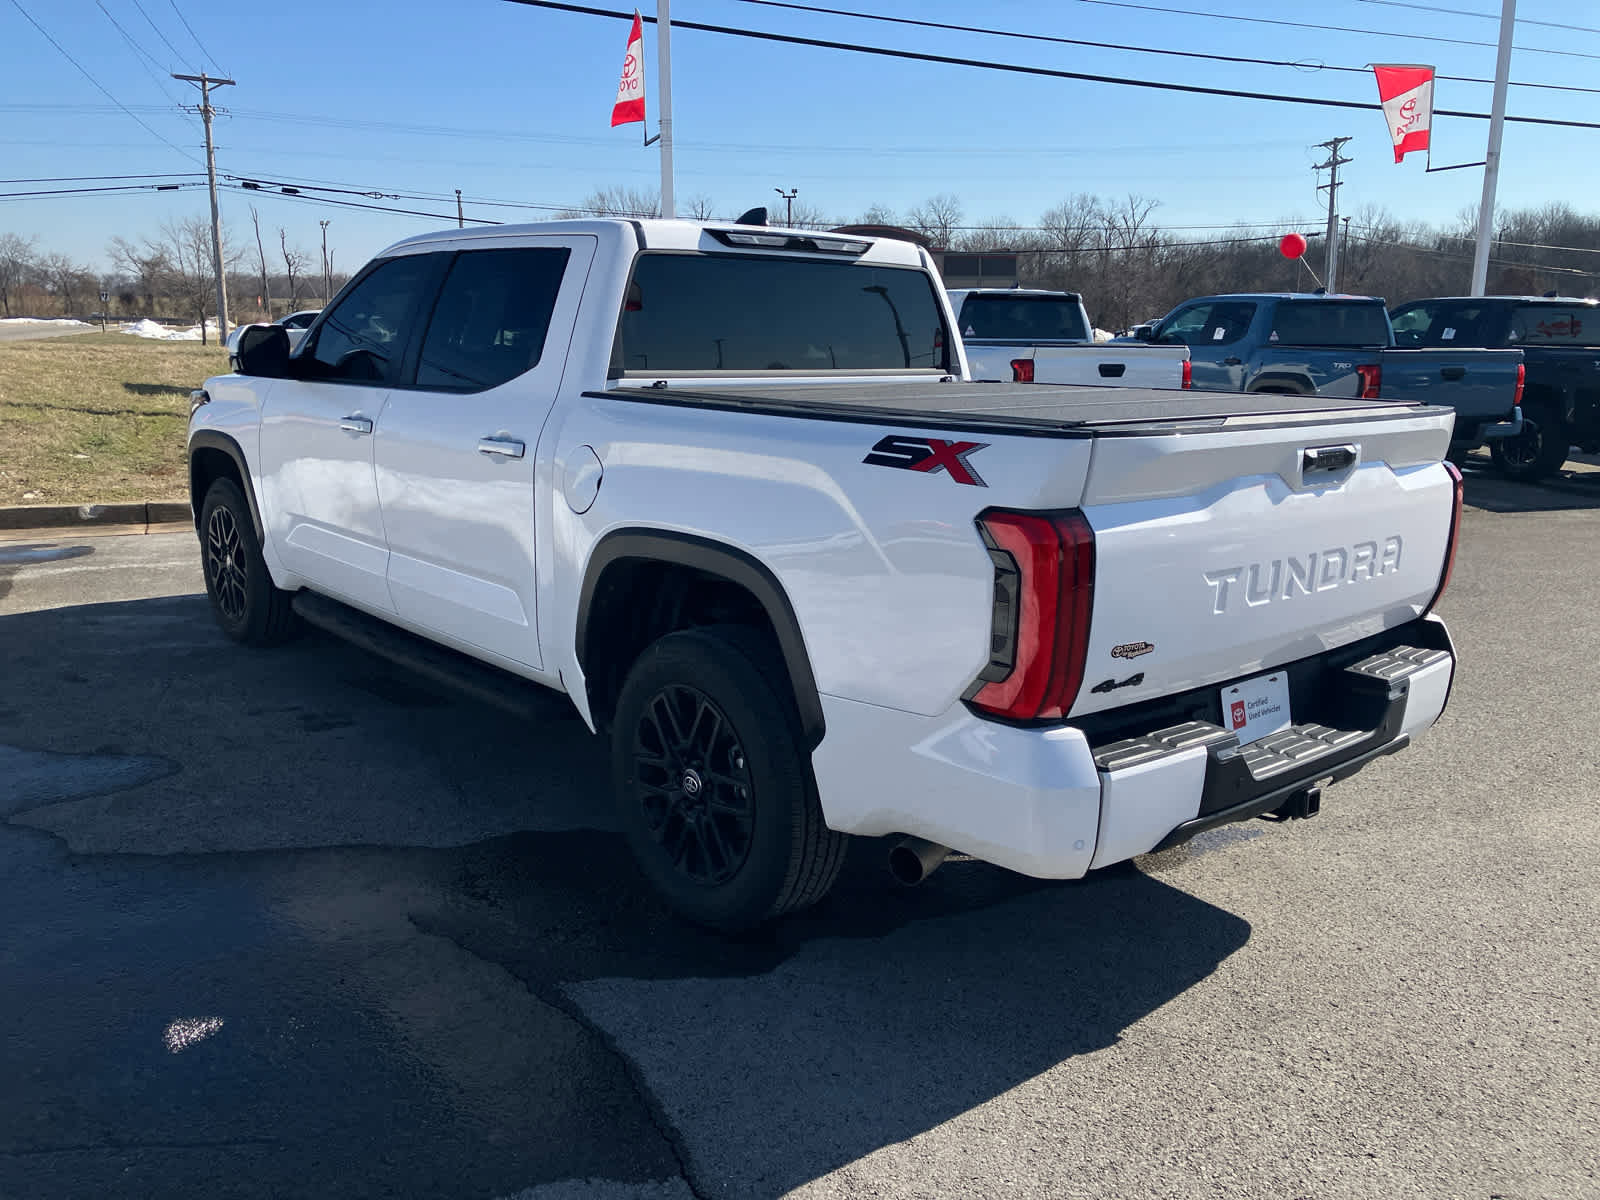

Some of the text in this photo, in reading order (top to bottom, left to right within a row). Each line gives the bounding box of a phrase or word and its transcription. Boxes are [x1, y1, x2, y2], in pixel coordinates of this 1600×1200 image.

[1202, 535, 1403, 614] TUNDRA
[1123, 642, 1145, 652] TOYOTA
[1247, 697, 1269, 709] Certified
[1248, 704, 1281, 720] Used Vehicles
